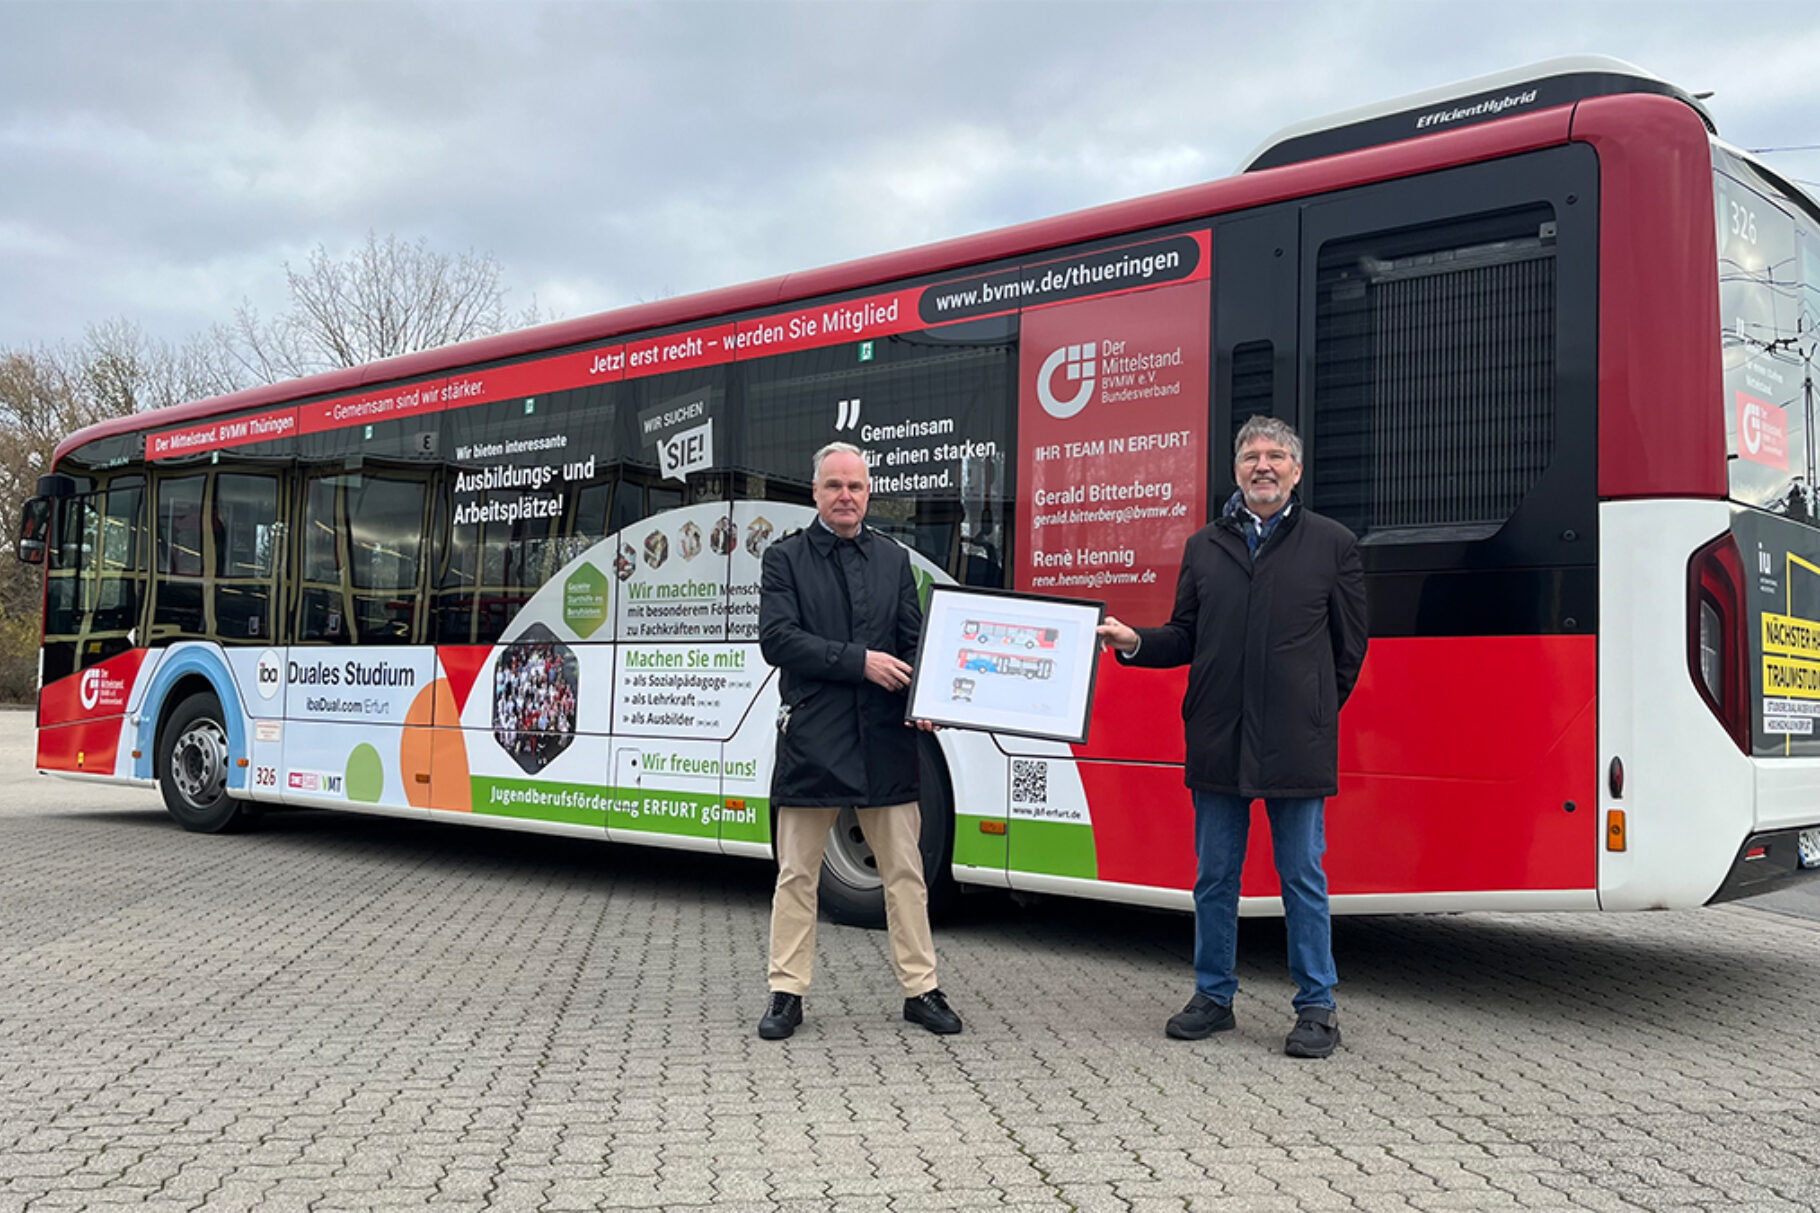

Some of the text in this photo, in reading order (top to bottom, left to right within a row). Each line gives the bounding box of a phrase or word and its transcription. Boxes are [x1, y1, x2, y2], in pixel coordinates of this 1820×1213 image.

[1415, 89, 1538, 129] EfficientHybrid
[1730, 200, 1757, 245] 326
[935, 249, 1180, 312] www.bvmw.de/thueringen
[589, 351, 625, 375] Jetzt
[629, 345, 659, 368] erst
[662, 336, 703, 362] recht
[722, 322, 784, 351] werden
[788, 315, 817, 340] Sie
[821, 298, 899, 335] Mitglied
[1102, 339, 1127, 358] Der
[1101, 346, 1184, 375] Mittelstand.
[1101, 374, 1136, 390] BVMW
[1101, 381, 1181, 404] Bundesverband
[333, 399, 395, 421] Gemeinsam
[395, 389, 420, 410] sind
[421, 386, 440, 405] wir
[440, 380, 486, 401] stärker.
[643, 402, 706, 434] WIR SUCHEN
[860, 417, 954, 443] Gemeinsam
[154, 437, 169, 452] Der
[219, 421, 248, 442] BVMW
[249, 415, 295, 436] Thüringen
[455, 433, 568, 461] Wir bieten interessante
[1035, 430, 1191, 462] IHR TEAM IN ERFURT
[666, 432, 705, 471] SIE!
[886, 446, 929, 467] einen
[932, 438, 997, 461] starken
[454, 454, 596, 494] Ausbildungs- und
[1034, 479, 1173, 507] Gerald Bitterberg
[452, 494, 564, 526] Arbeitsplätze!
[1033, 501, 1188, 530] gerald.bitterberg@bvmw.de
[1076, 544, 1136, 568] Hennig
[627, 580, 654, 600] Wir
[656, 578, 717, 599] machen
[1031, 569, 1158, 589] rene.hennig@bvmw.de
[627, 602, 645, 618] mit
[645, 602, 710, 618] besonderem
[626, 624, 639, 637] zu
[640, 621, 701, 636] Fachkräften
[702, 623, 723, 635] von
[625, 648, 746, 668] Machen Sie mit!
[258, 662, 279, 684] iba
[287, 660, 415, 687] Duales Studium
[632, 674, 647, 688] als
[648, 673, 727, 691] Sozialpädagoge
[305, 696, 390, 715] ibaDual.com Erfurt
[631, 692, 646, 706] als
[647, 693, 696, 707] Lehrkraft
[630, 711, 646, 725] als
[646, 712, 695, 727] Ausbilder
[255, 766, 277, 787] 326
[641, 752, 757, 778] Wir freuen uns!
[489, 785, 757, 826] Jugendberufsförderung ERFURT gGmbH
